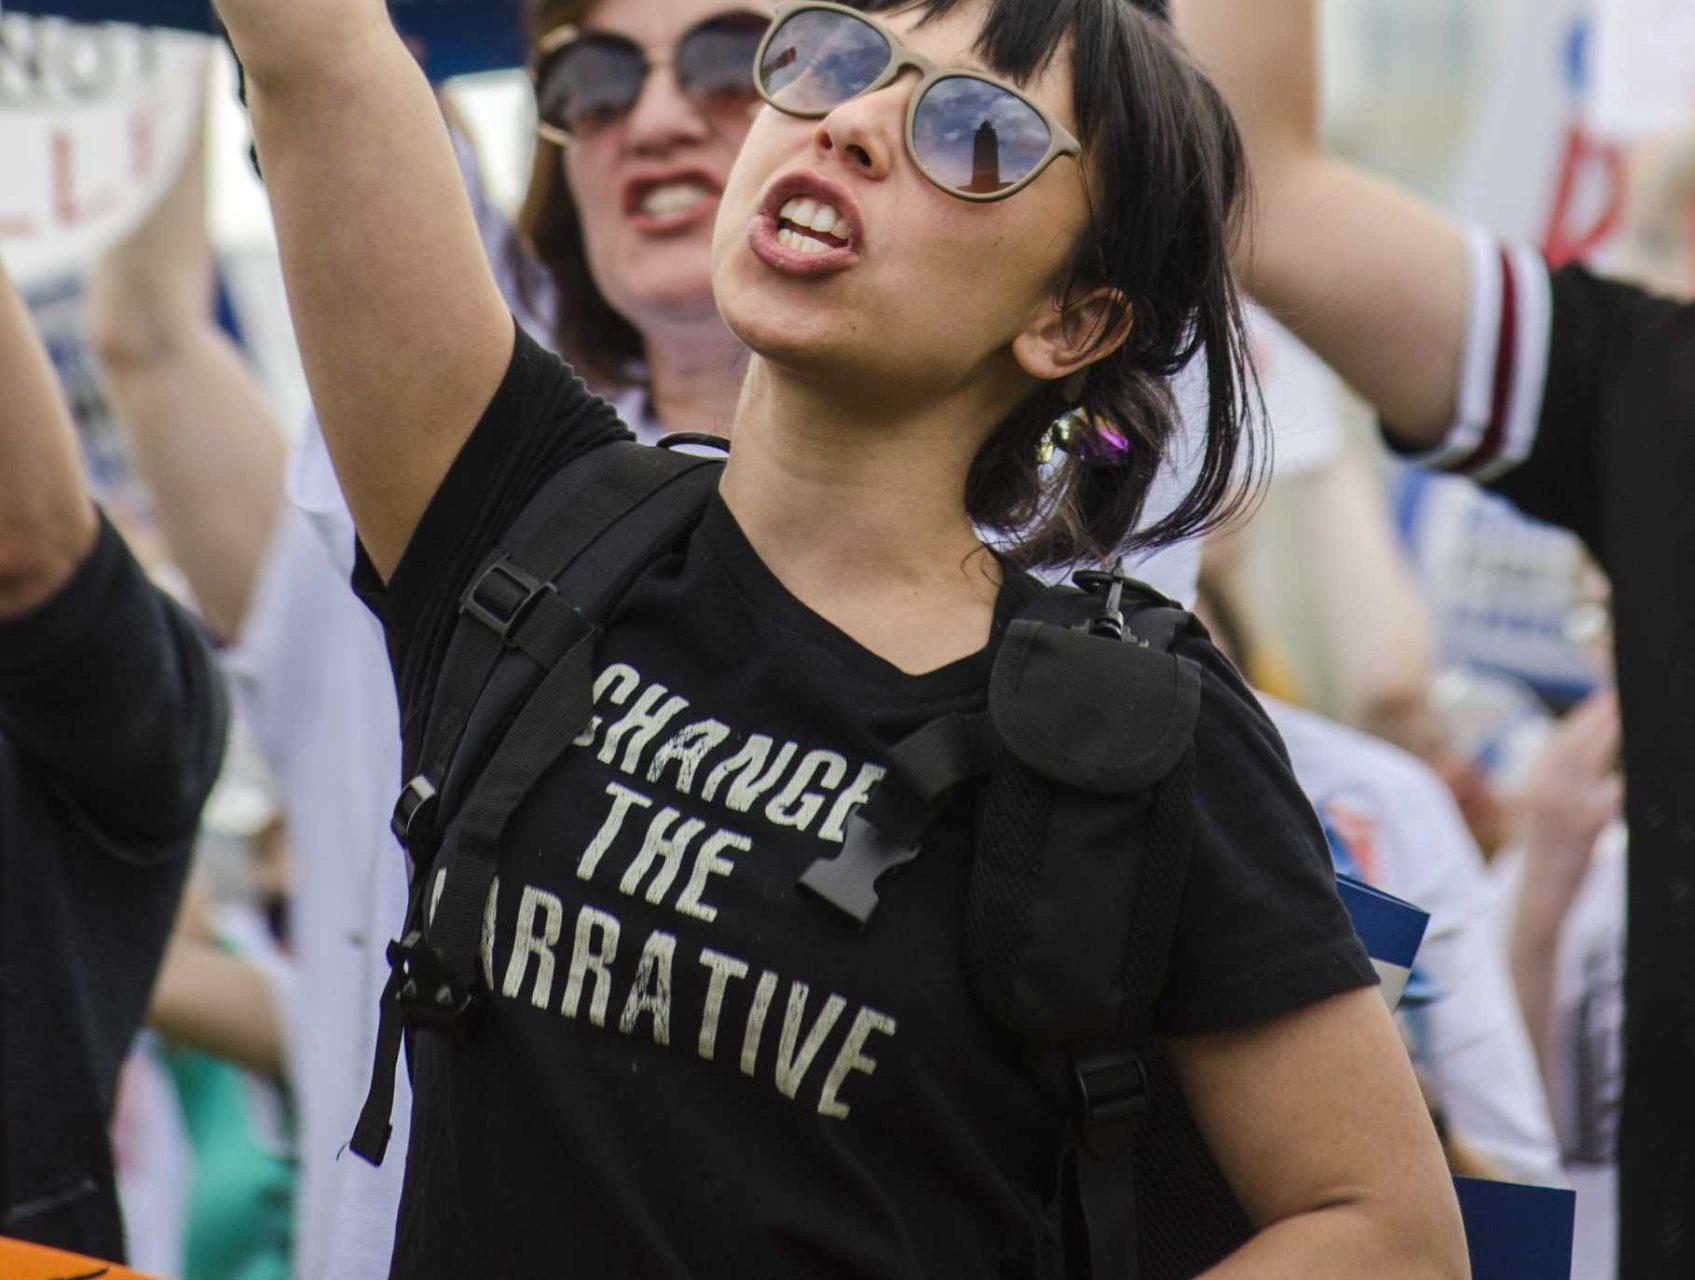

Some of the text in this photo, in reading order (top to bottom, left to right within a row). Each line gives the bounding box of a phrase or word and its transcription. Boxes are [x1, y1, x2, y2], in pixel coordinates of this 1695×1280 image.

[572, 663, 887, 843] CHANGE
[576, 781, 752, 922] THE
[430, 867, 897, 1120] RRATIVE
